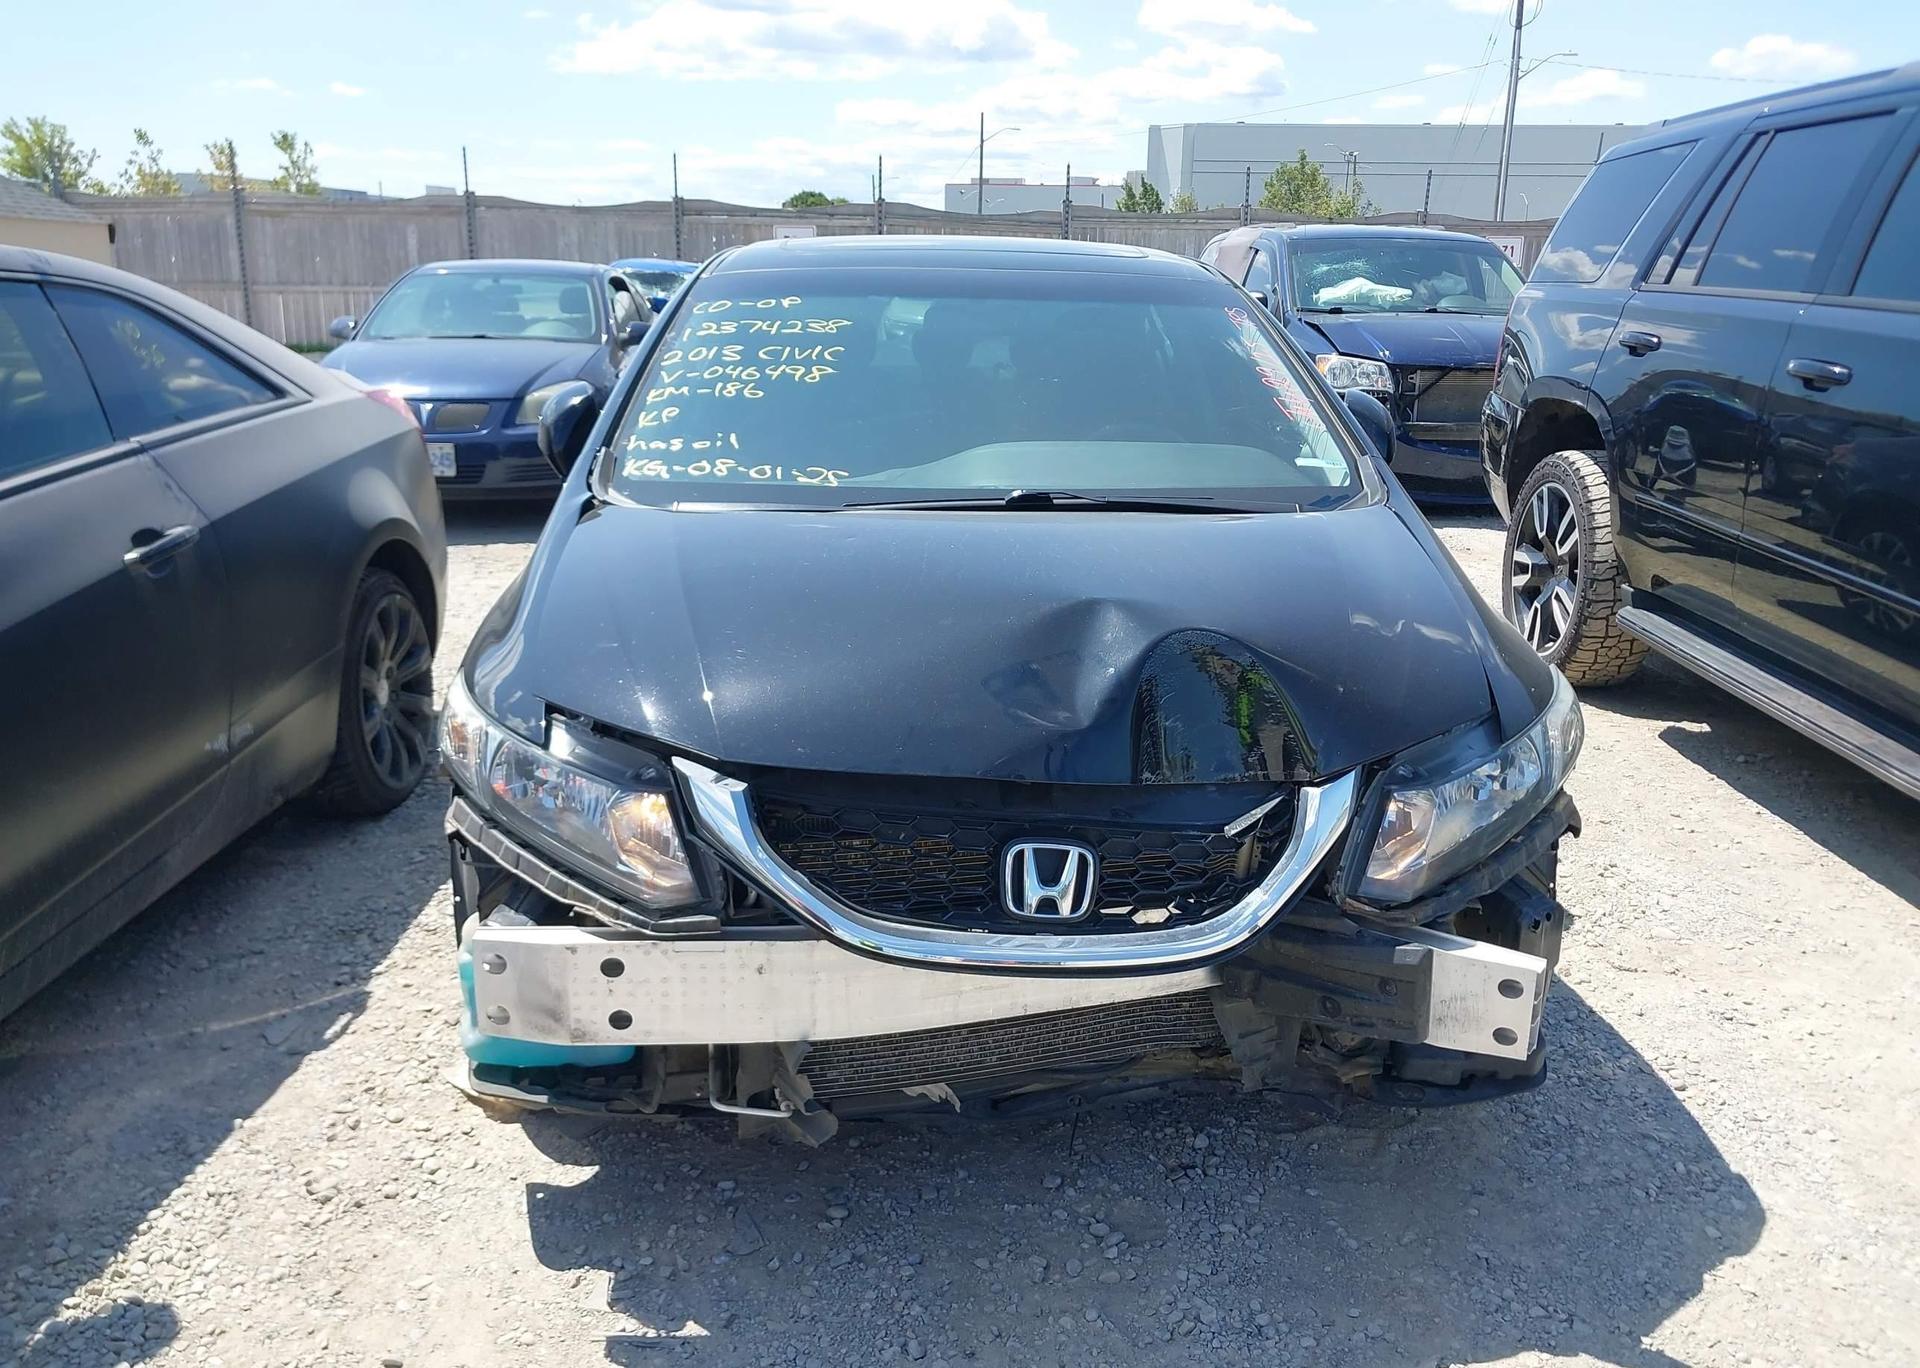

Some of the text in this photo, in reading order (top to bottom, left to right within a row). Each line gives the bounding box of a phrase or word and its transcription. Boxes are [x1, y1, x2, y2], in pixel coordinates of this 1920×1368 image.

[682, 319, 853, 342] 12374238
[660, 345, 846, 366] 2013 CIVIC
[660, 364, 840, 384] V-046498
[638, 406, 680, 429] KP
[626, 434, 684, 451] has
